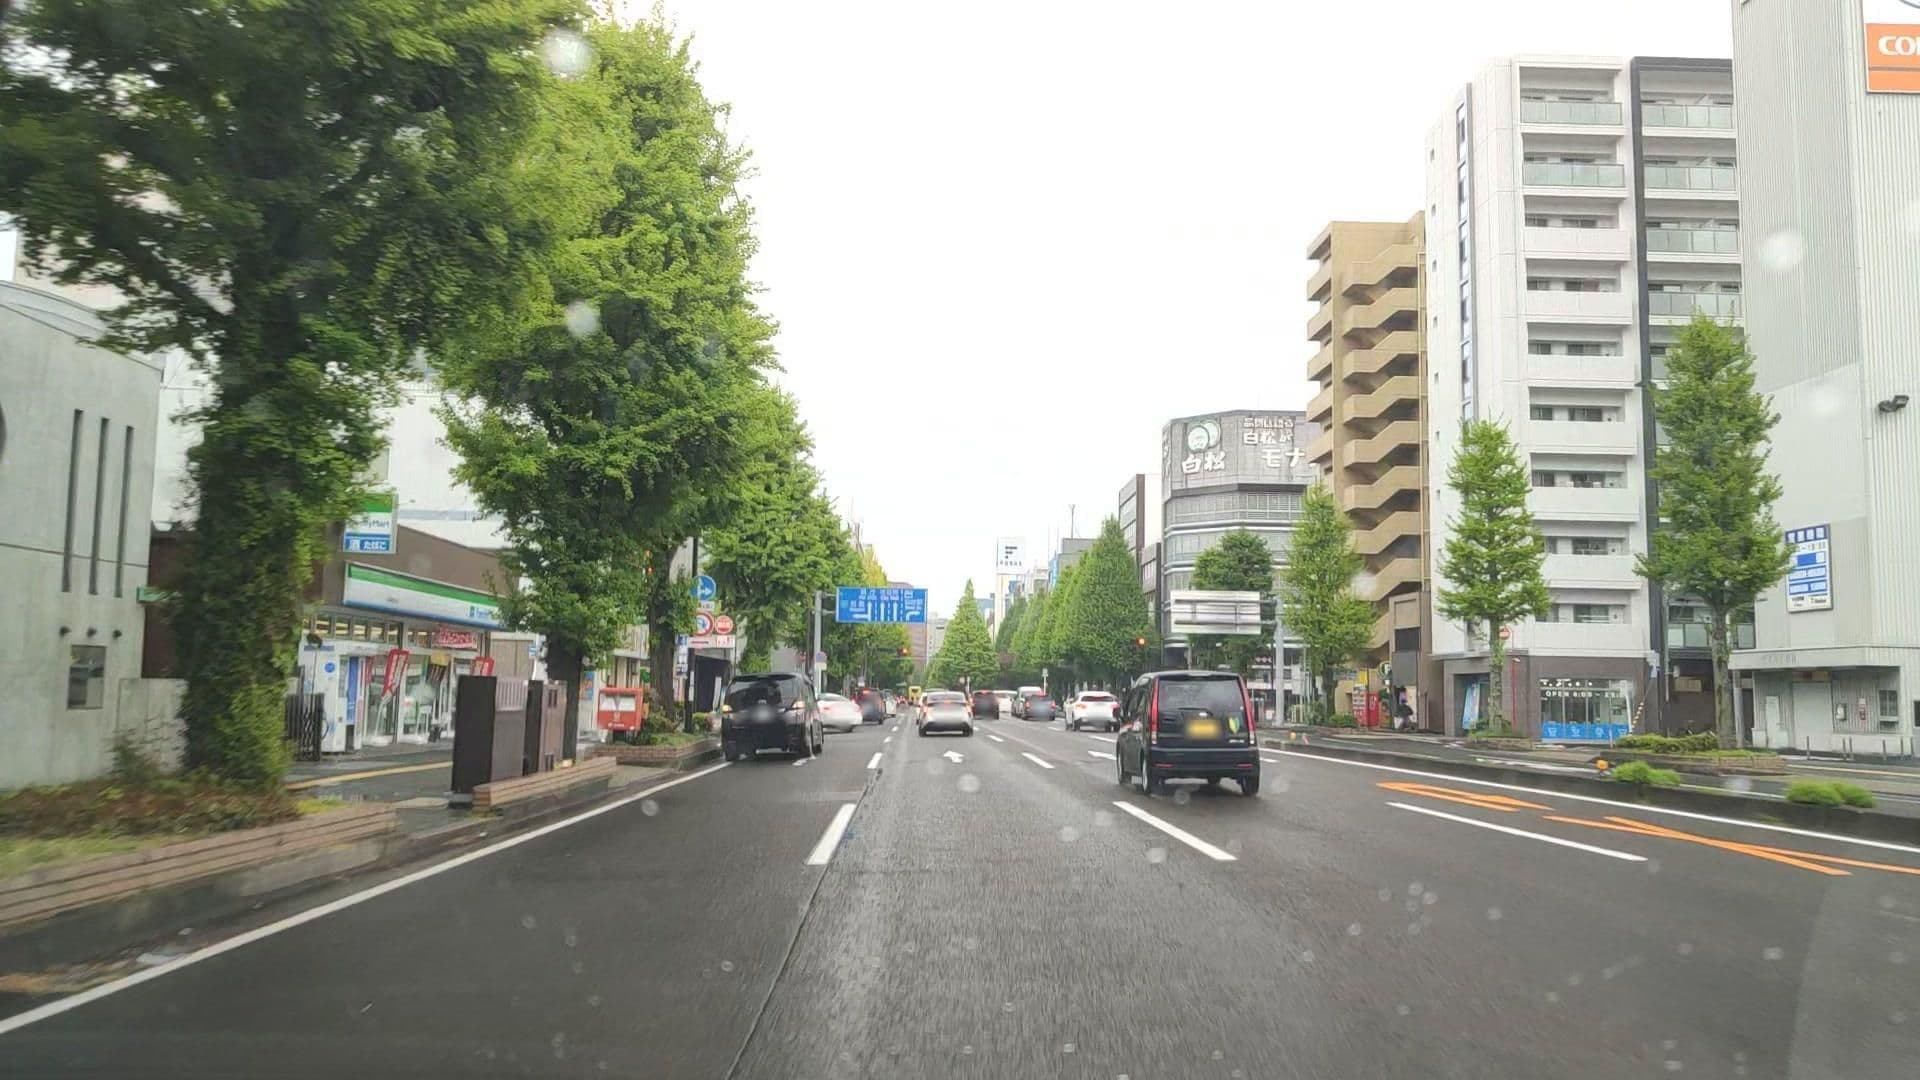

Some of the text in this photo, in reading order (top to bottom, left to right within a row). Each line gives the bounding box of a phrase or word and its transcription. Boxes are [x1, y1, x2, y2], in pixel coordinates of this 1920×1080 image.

[1878, 34, 1920, 56] CO
[1243, 429, 1294, 445] 白松が
[1182, 450, 1226, 474] 白松
[1261, 447, 1316, 468] モナ
[363, 540, 388, 551] たばこ
